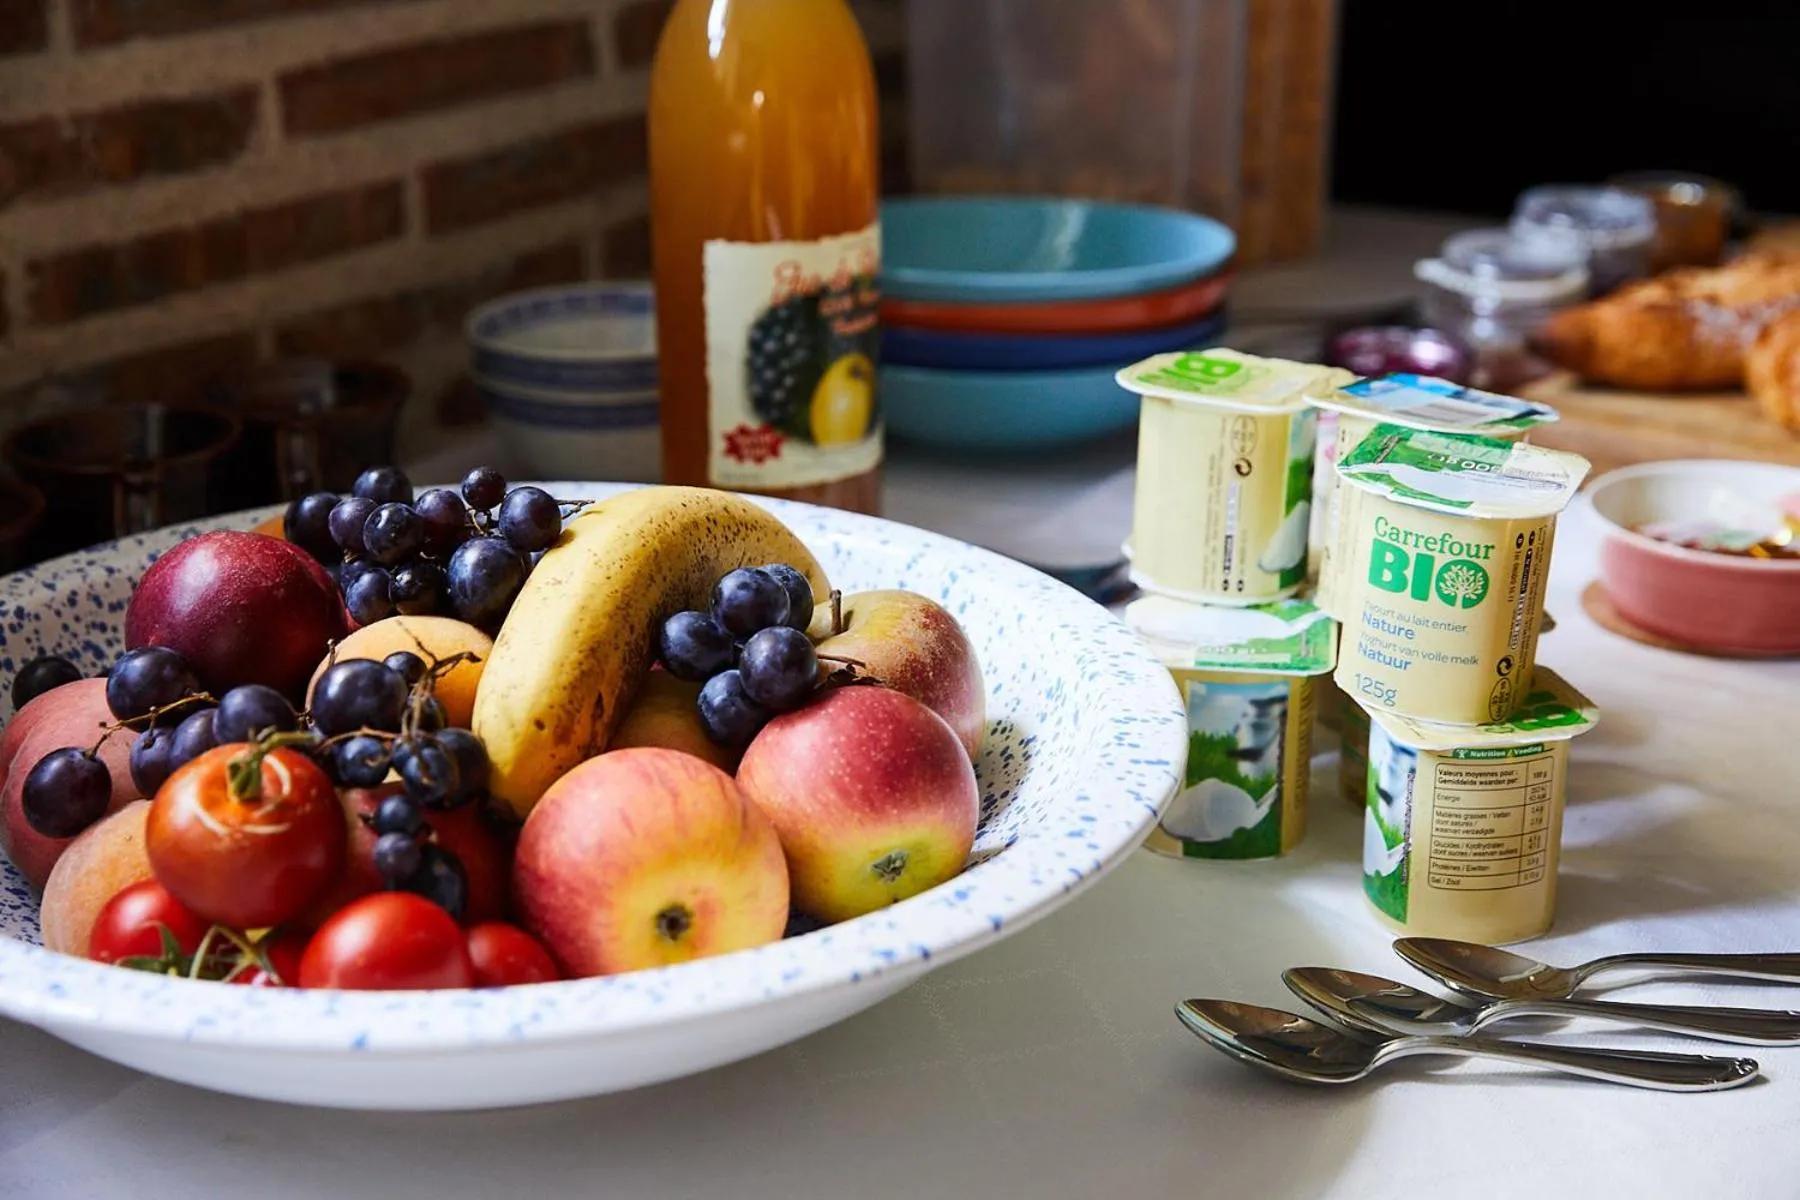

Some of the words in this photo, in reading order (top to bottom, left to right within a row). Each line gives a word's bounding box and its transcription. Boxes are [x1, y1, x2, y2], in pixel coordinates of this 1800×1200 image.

[1374, 516, 1496, 560] Carrefour
[1368, 537, 1490, 609] BIO
[1362, 610, 1416, 640] Nature
[1431, 620, 1468, 633] entier
[1358, 640, 1412, 671] Natuur
[1399, 645, 1419, 657] van
[1421, 651, 1449, 664] volle
[1450, 655, 1480, 666] melk
[1355, 672, 1398, 708] 125g
[1469, 749, 1506, 758] Nutrition
[1438, 768, 1463, 777] Valeurs
[1464, 770, 1499, 779] moyennes
[1438, 777, 1477, 785] Gemiddelde
